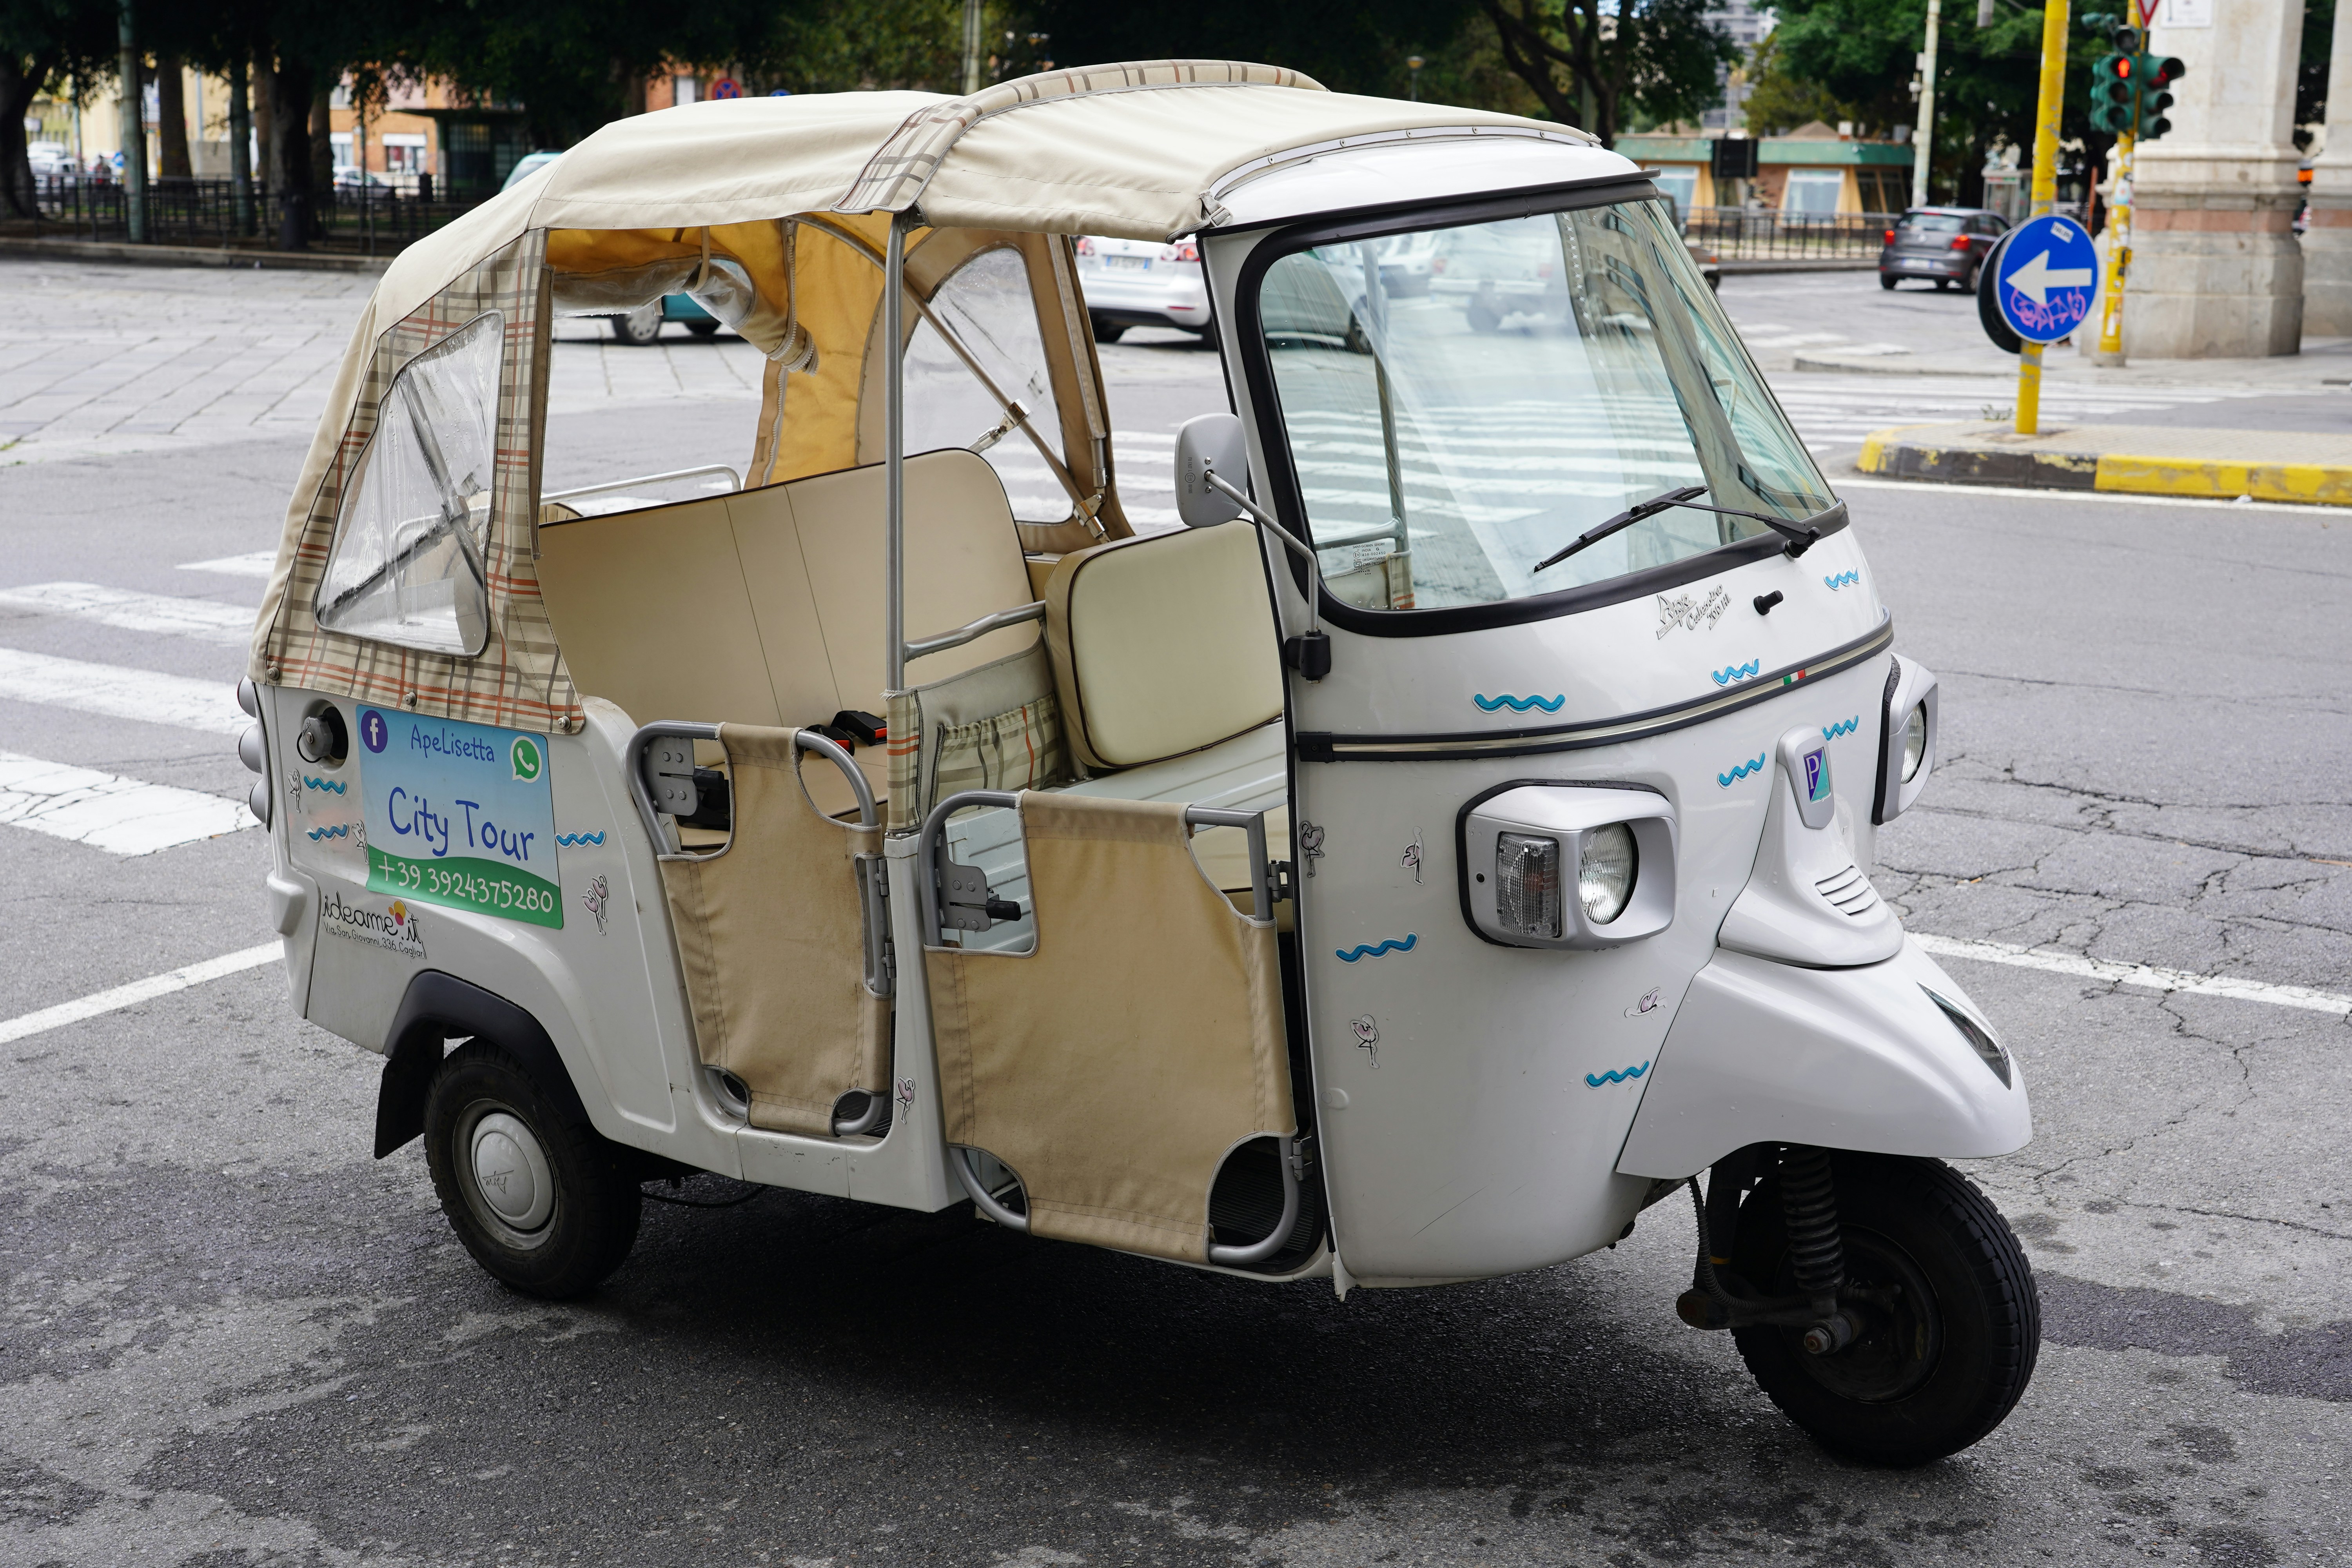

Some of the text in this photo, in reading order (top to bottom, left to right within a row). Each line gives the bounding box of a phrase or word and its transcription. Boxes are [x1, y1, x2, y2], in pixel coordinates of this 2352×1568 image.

[1657, 593, 1694, 629] Ape
[1686, 584, 1723, 630] Calessino
[1707, 603, 1724, 630] 200
[411, 724, 495, 762] ApeLisetta
[1806, 755, 1819, 790] P
[388, 787, 534, 861] City Tour
[378, 855, 553, 913] +39 3924375280
[352, 930, 379, 946] Giovanni
[382, 938, 396, 950] 336
[399, 942, 425, 958] Cagliari
[483, 1171, 512, 1194] Ape
